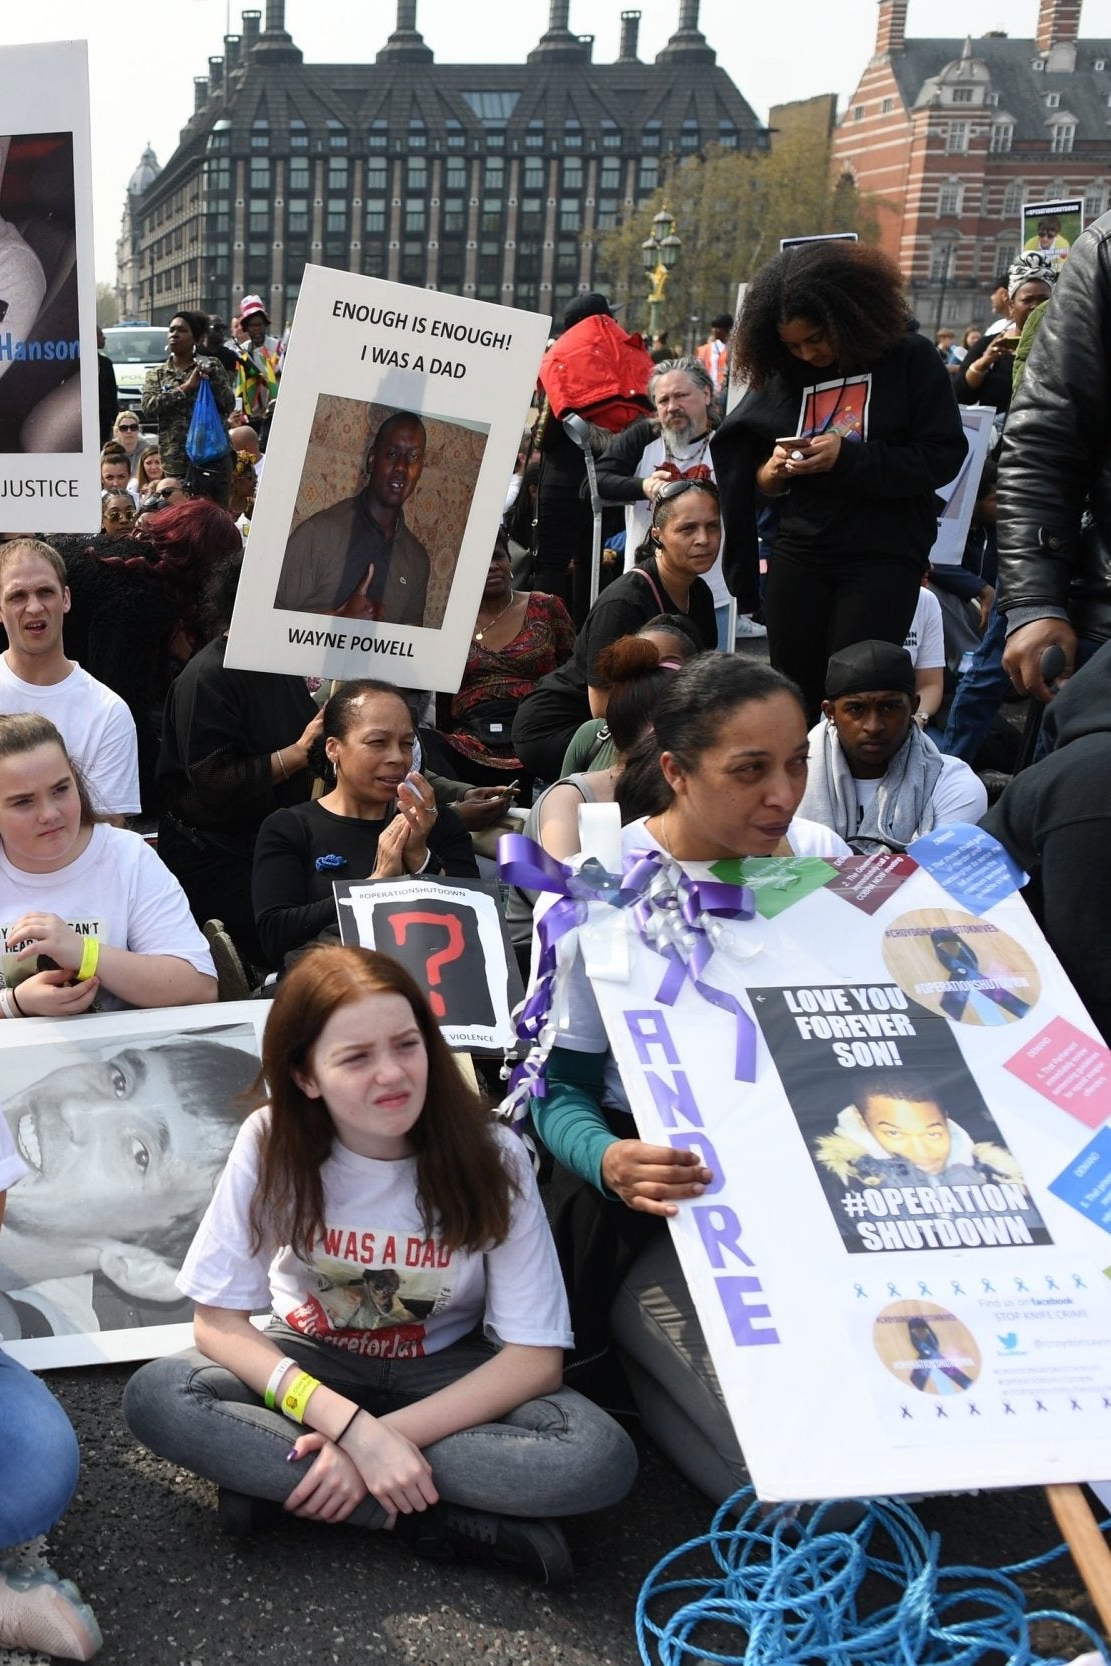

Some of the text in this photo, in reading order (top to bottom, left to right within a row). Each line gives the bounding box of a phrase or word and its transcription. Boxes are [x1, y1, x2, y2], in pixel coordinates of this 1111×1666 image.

[332, 300, 512, 350] ENOUGH IS ENOUGH!
[361, 345, 467, 379] I WAS A DAD
[1, 479, 79, 498] JUSTICE
[288, 628, 414, 657] WAYNE POWELL
[359, 888, 466, 899] #OPERATIONSHUTDOWN
[68, 922, 99, 936] AN'T
[783, 987, 909, 1013] LOVE YOU
[450, 1033, 495, 1043] VIOLENCE
[794, 1013, 916, 1040] FOREVER
[832, 1041, 903, 1067] SON!
[842, 1183, 1029, 1217] #OPERATION
[856, 1216, 1034, 1250] SHUTDOWN
[323, 1228, 375, 1264] WAS
[382, 1236, 397, 1265] A
[405, 1237, 453, 1268] DAD
